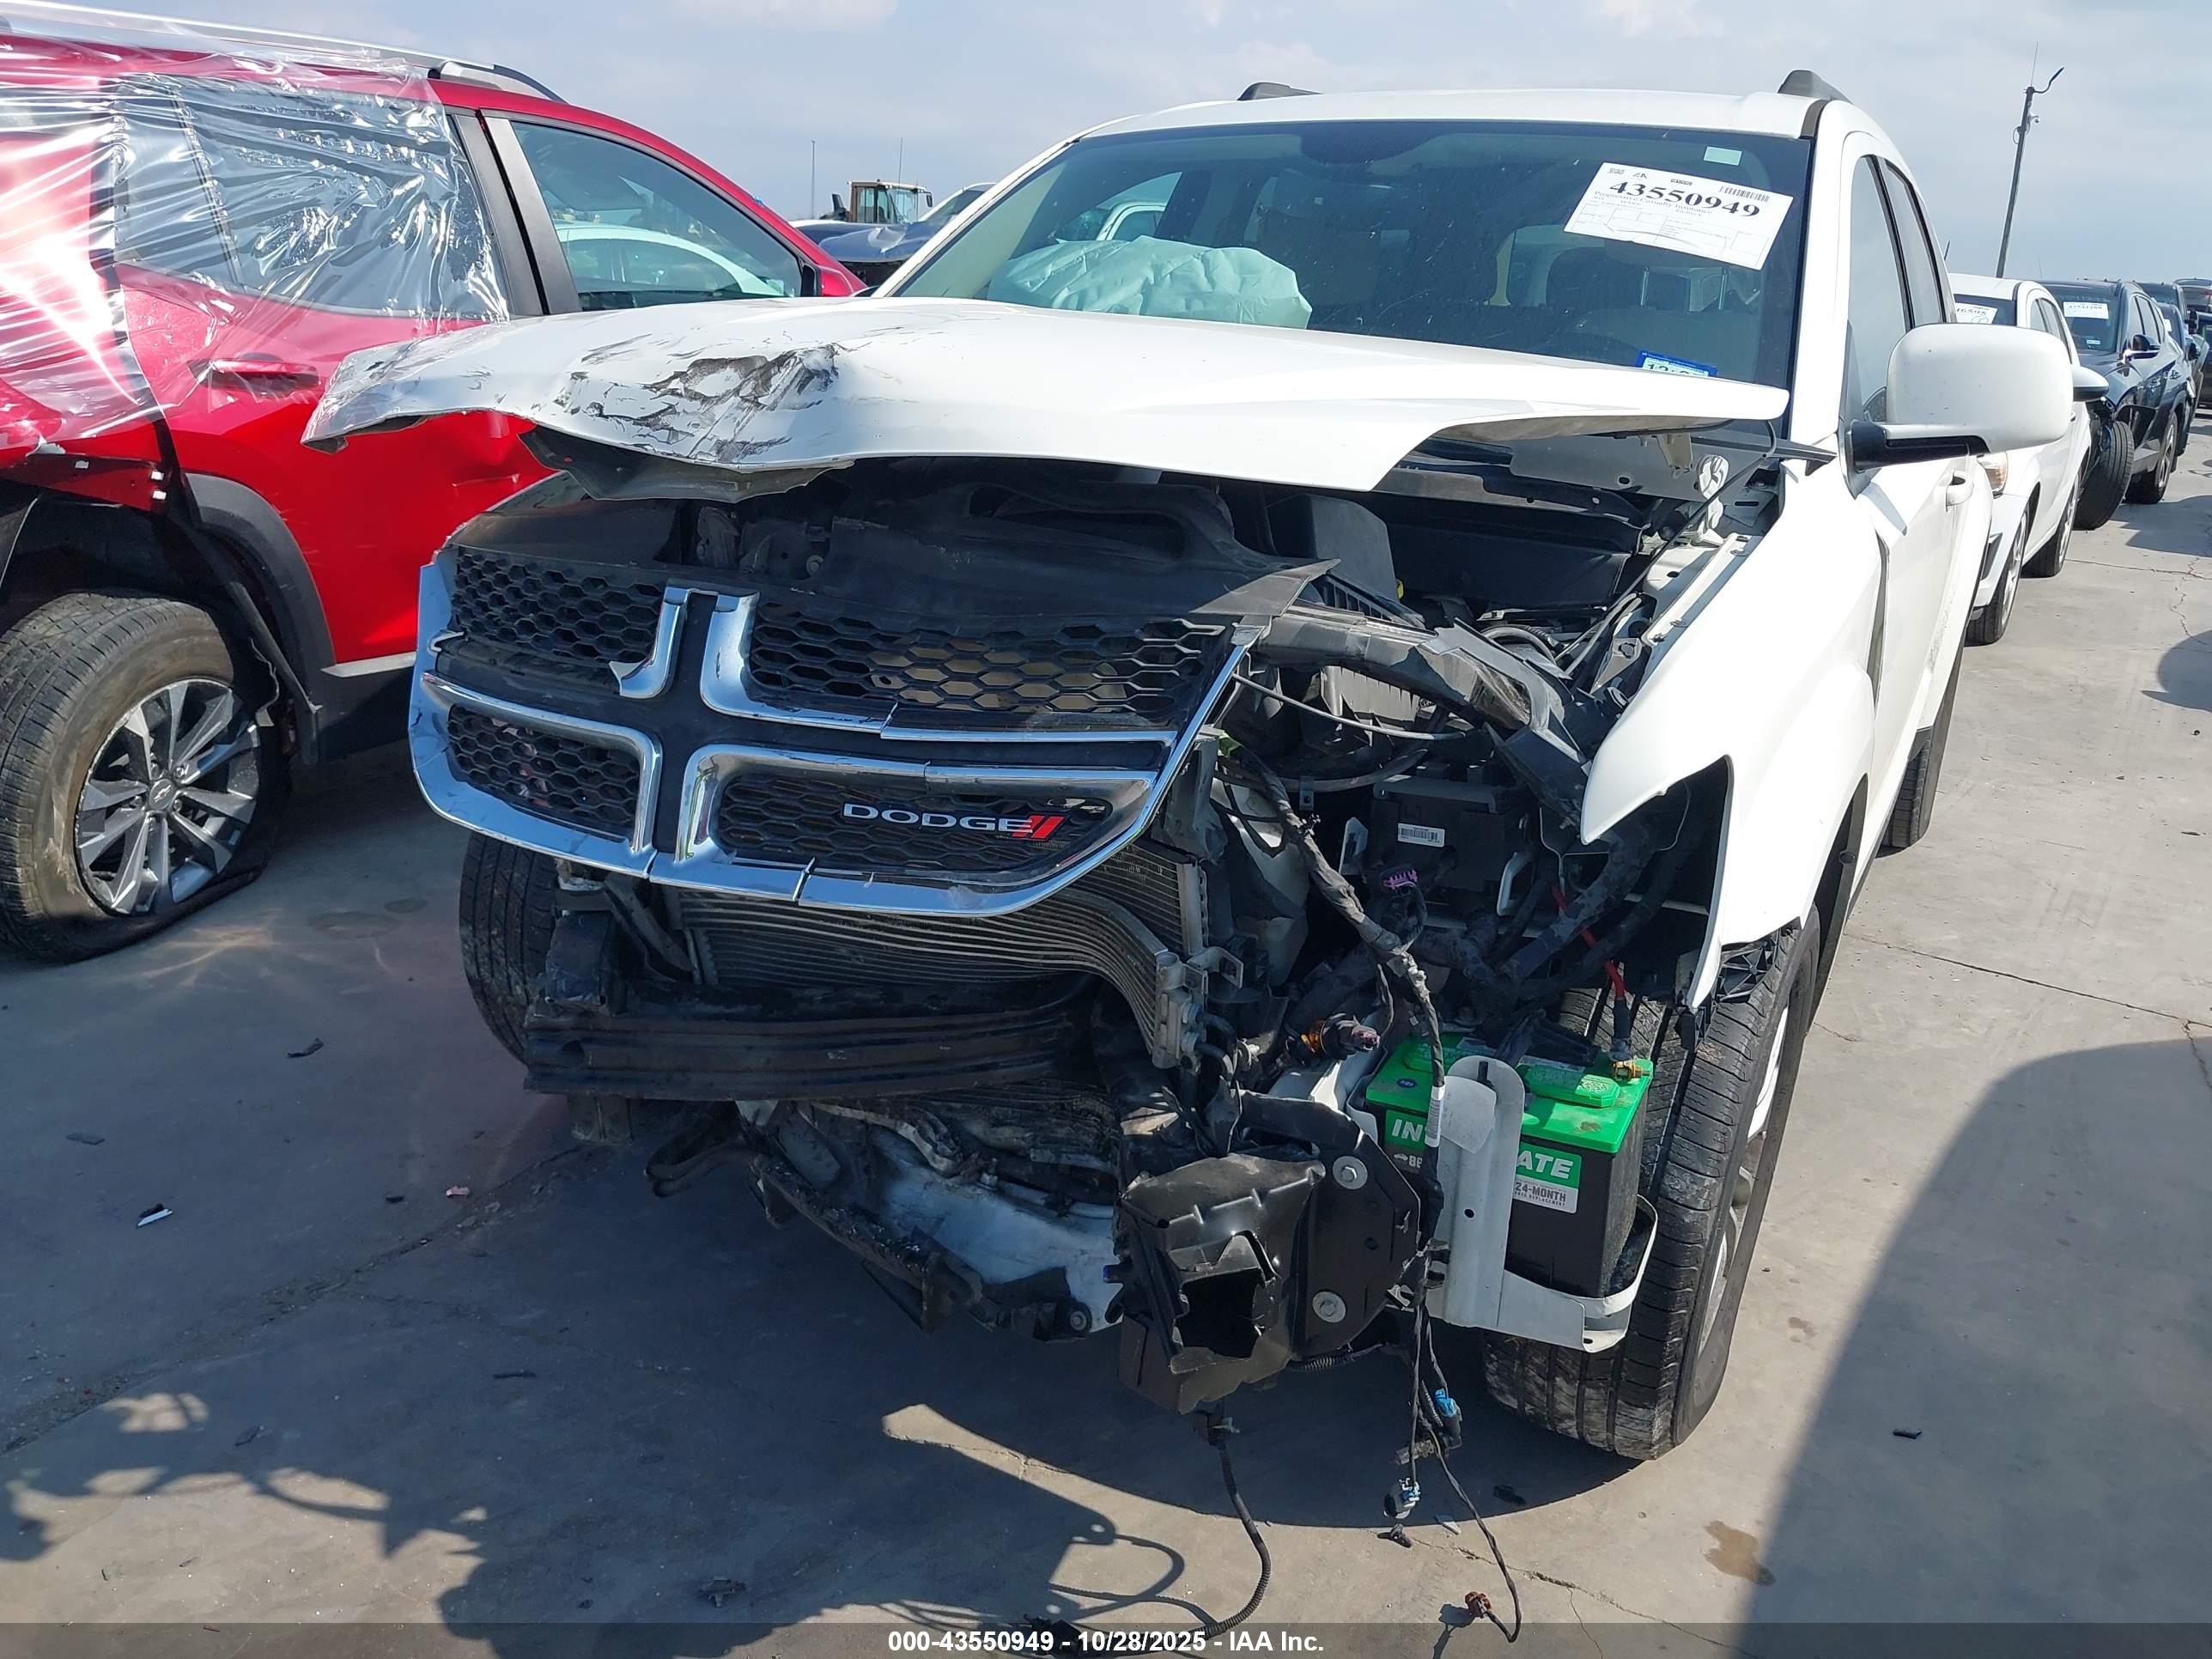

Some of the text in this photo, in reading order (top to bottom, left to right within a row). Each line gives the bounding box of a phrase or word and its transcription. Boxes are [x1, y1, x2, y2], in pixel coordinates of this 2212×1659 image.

[1609, 181, 1760, 217] 43550949
[842, 803, 1033, 833] DODGE
[1391, 1119, 1425, 1142] IN
[1515, 1182, 1566, 1202] 24-MONTH
